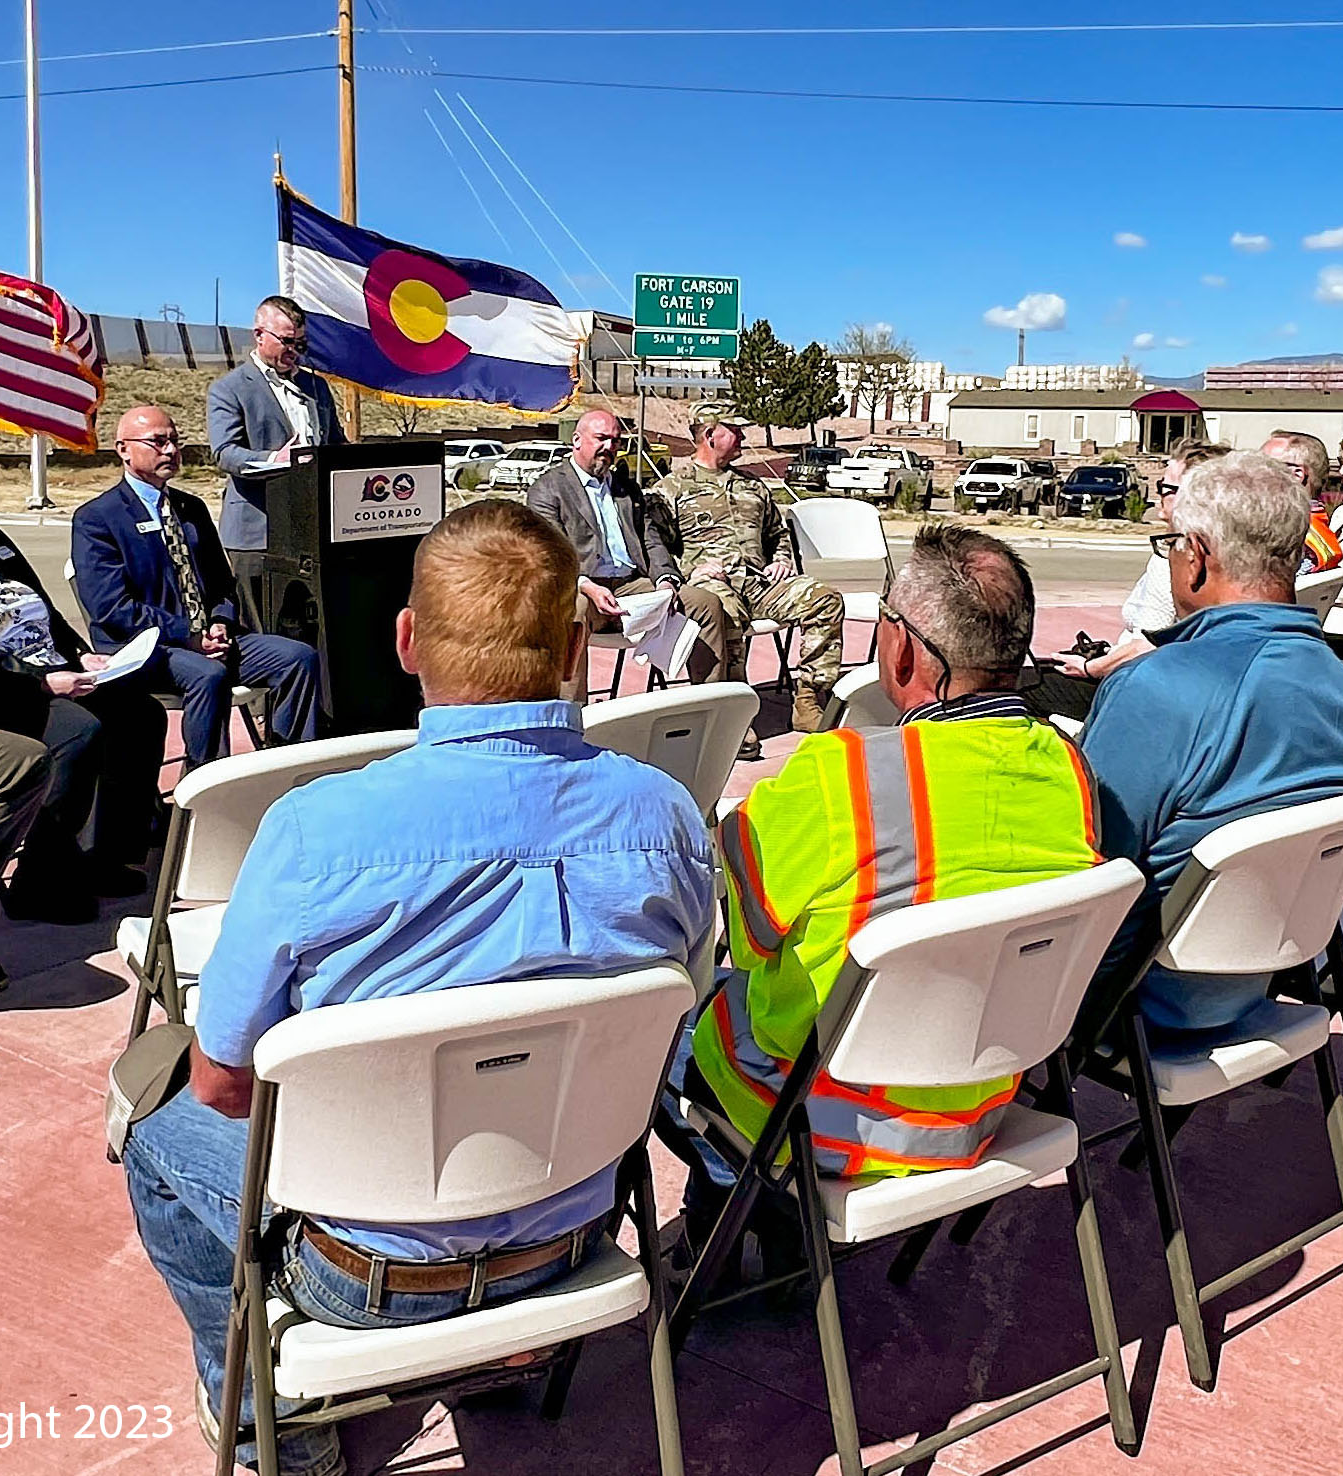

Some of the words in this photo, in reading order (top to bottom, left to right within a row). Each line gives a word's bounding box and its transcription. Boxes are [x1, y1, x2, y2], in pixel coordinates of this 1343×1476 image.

[641, 278, 675, 292] FORT
[681, 280, 733, 294] CARSON
[659, 295, 694, 309] GATE
[700, 297, 715, 310] 19
[666, 312, 671, 325] 1
[676, 312, 708, 326] MILE
[653, 333, 675, 344] 5AM
[682, 335, 693, 345] to
[699, 336, 720, 345] 6PM
[676, 346, 695, 355] M-F
[355, 508, 421, 521] COLORADO
